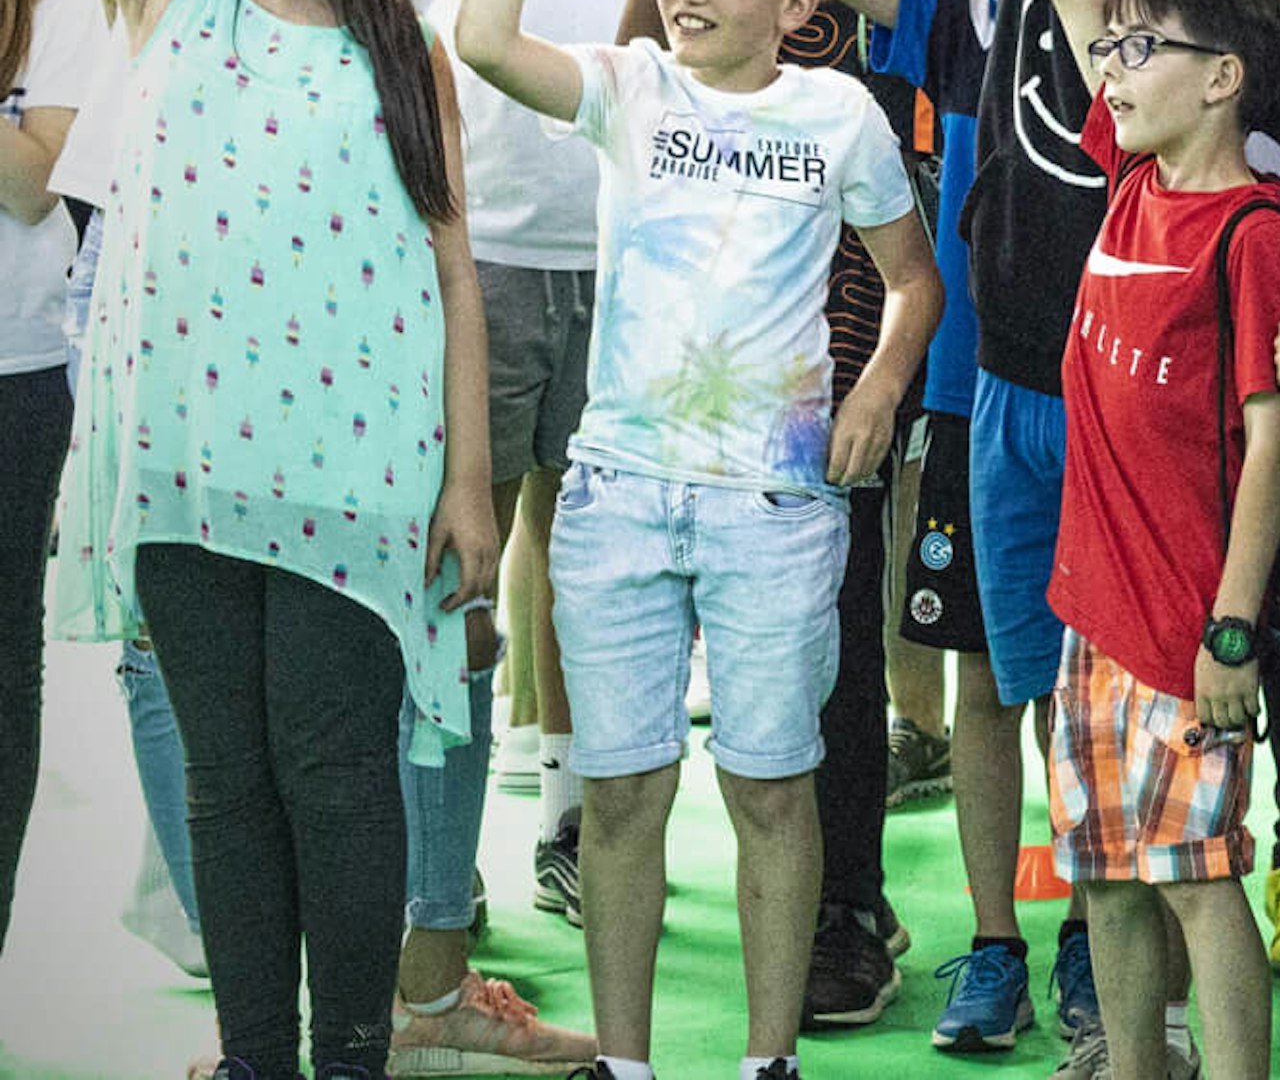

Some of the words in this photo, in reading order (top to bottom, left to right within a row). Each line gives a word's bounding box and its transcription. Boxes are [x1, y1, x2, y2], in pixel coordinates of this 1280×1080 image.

[757, 128, 819, 157] EXPLORE
[651, 156, 718, 182] PARADISE
[667, 130, 826, 186] SUMMER
